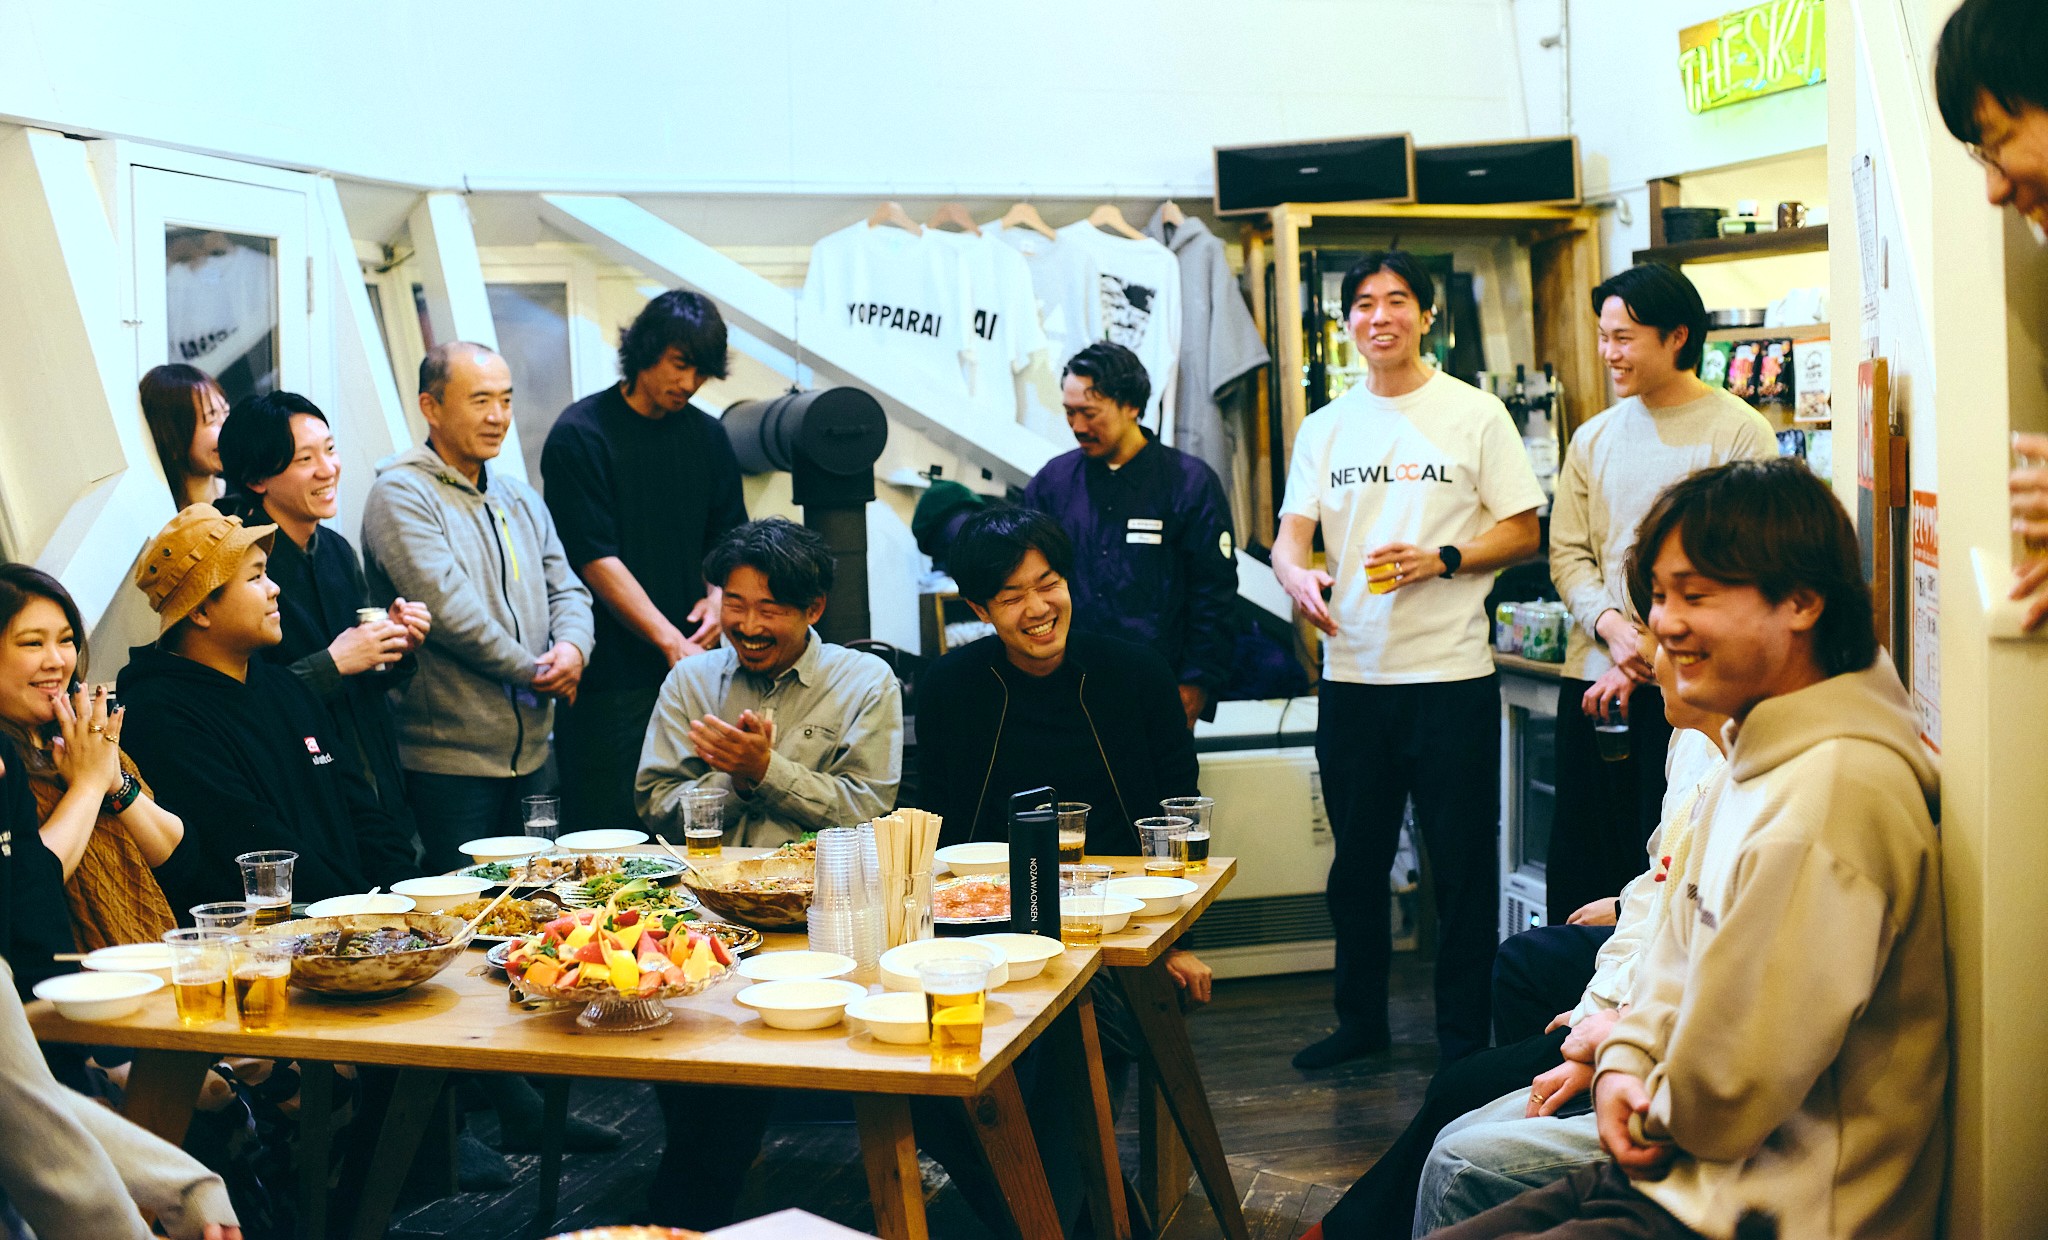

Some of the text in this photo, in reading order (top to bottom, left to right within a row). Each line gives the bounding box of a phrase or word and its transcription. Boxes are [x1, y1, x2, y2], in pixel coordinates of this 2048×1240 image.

[848, 303, 942, 338] YOPPARAI
[1331, 463, 1453, 488] NEWLOCAL
[1029, 857, 1038, 922] NOZAWAONSEN
